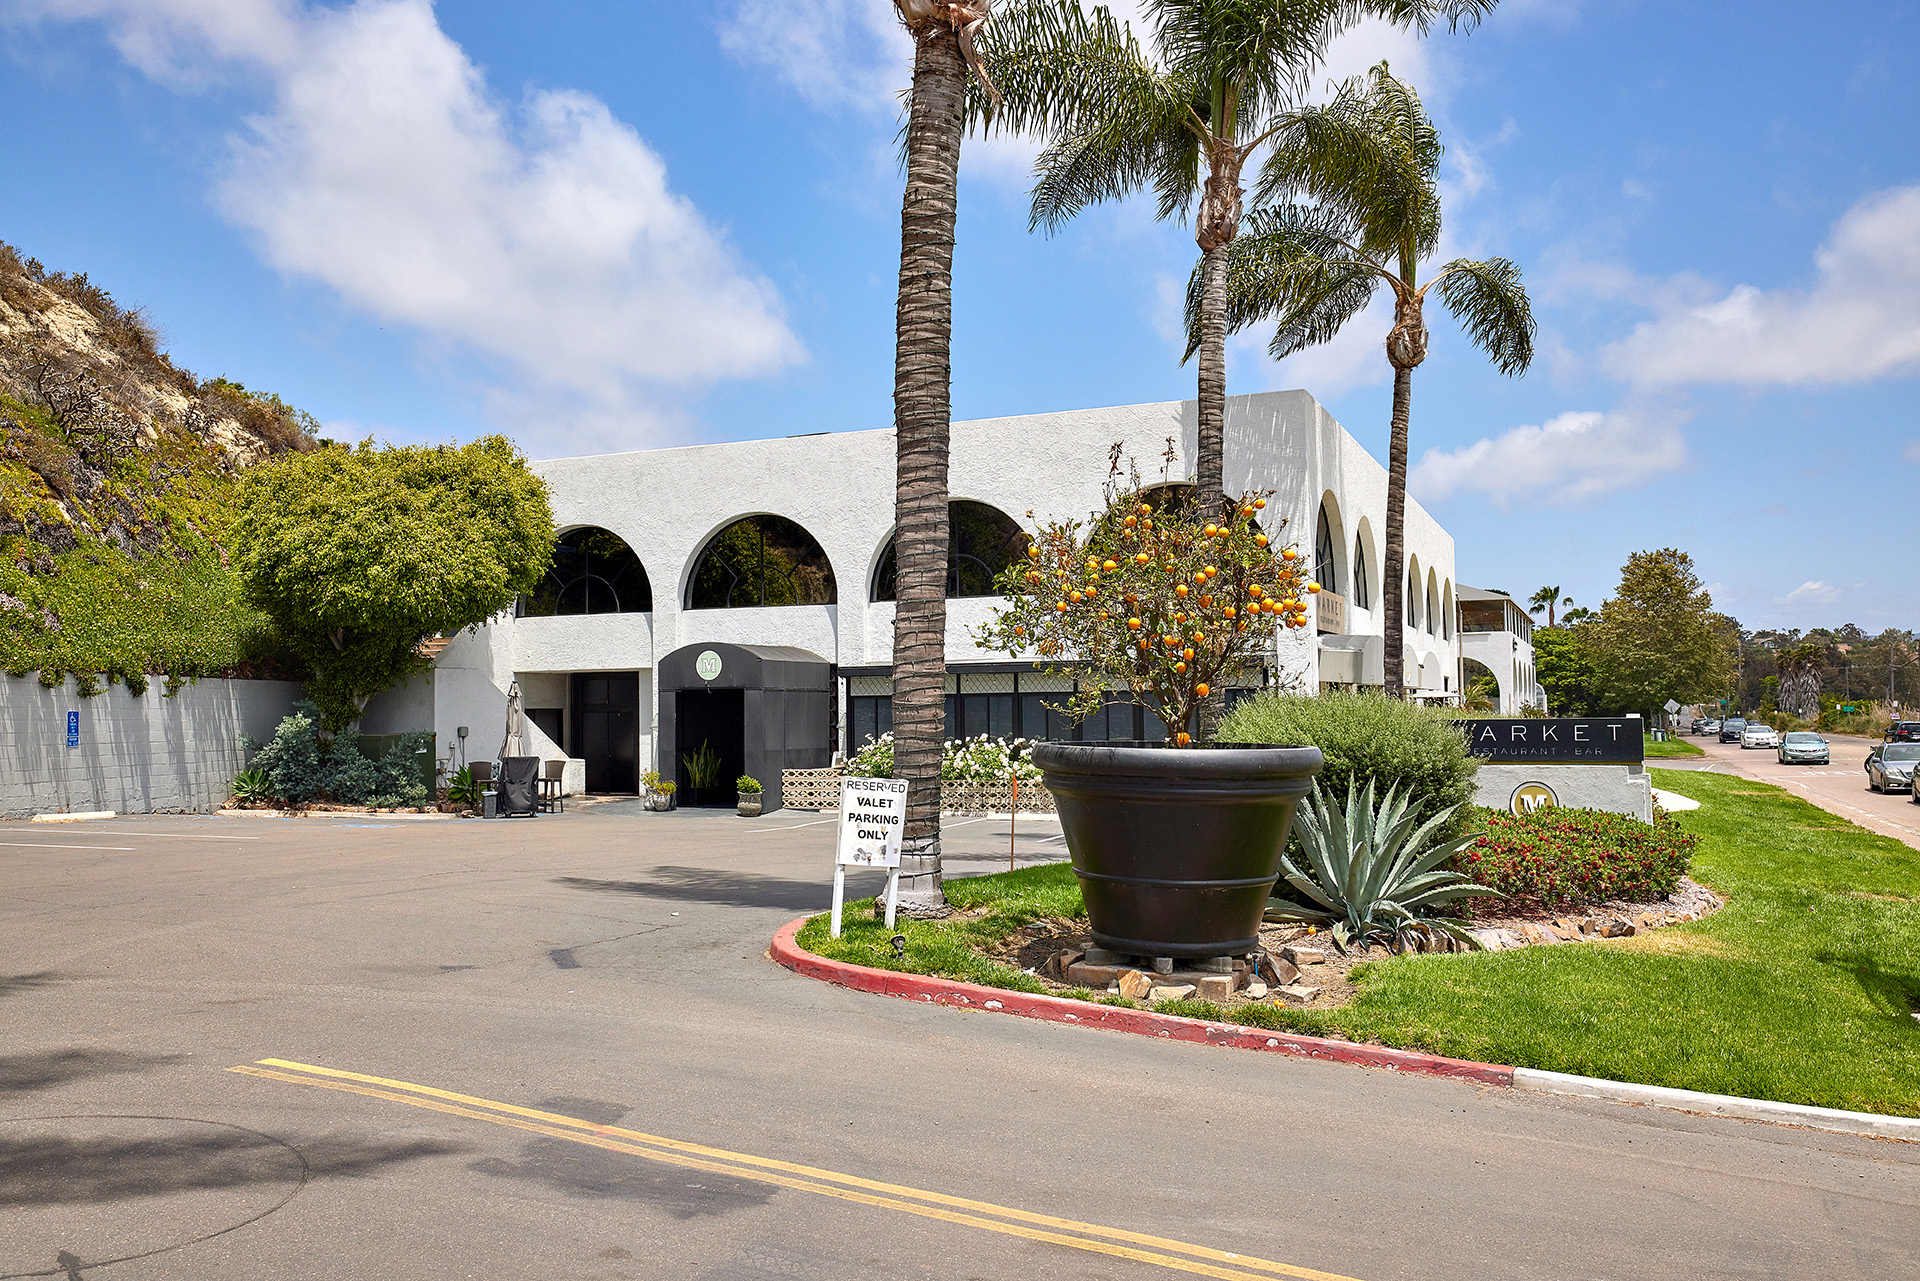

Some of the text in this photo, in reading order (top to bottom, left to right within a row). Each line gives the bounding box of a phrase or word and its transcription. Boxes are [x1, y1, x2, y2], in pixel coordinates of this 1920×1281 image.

[701, 658, 717, 673] M
[1462, 725, 1622, 741] ARKET
[1472, 747, 1603, 755] ESTAURANT BAR
[847, 780, 906, 793] RESERVED
[857, 797, 894, 808] VALET
[1520, 795, 1547, 813] M
[848, 813, 899, 825] PARKING
[858, 829, 889, 840] ONLY
